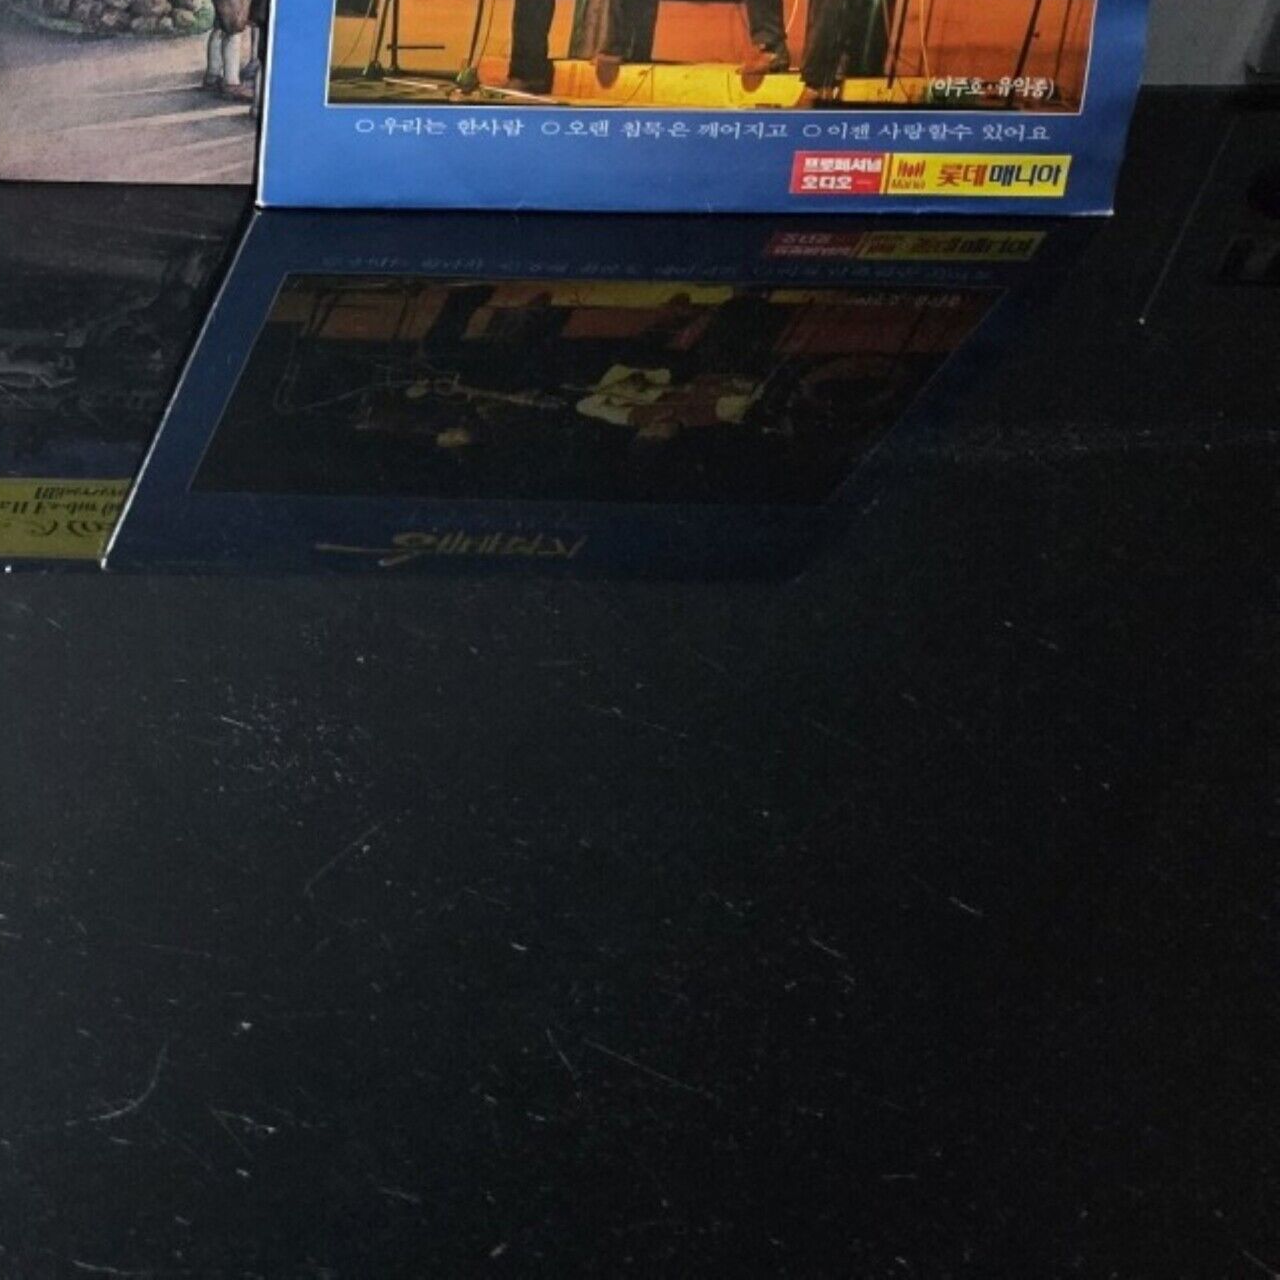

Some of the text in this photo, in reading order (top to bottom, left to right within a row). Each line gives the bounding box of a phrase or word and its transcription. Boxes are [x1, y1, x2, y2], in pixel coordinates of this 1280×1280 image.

[458, 119, 524, 136] 한사람
[983, 123, 1050, 141] 있어요
[801, 175, 852, 189] 오디오
